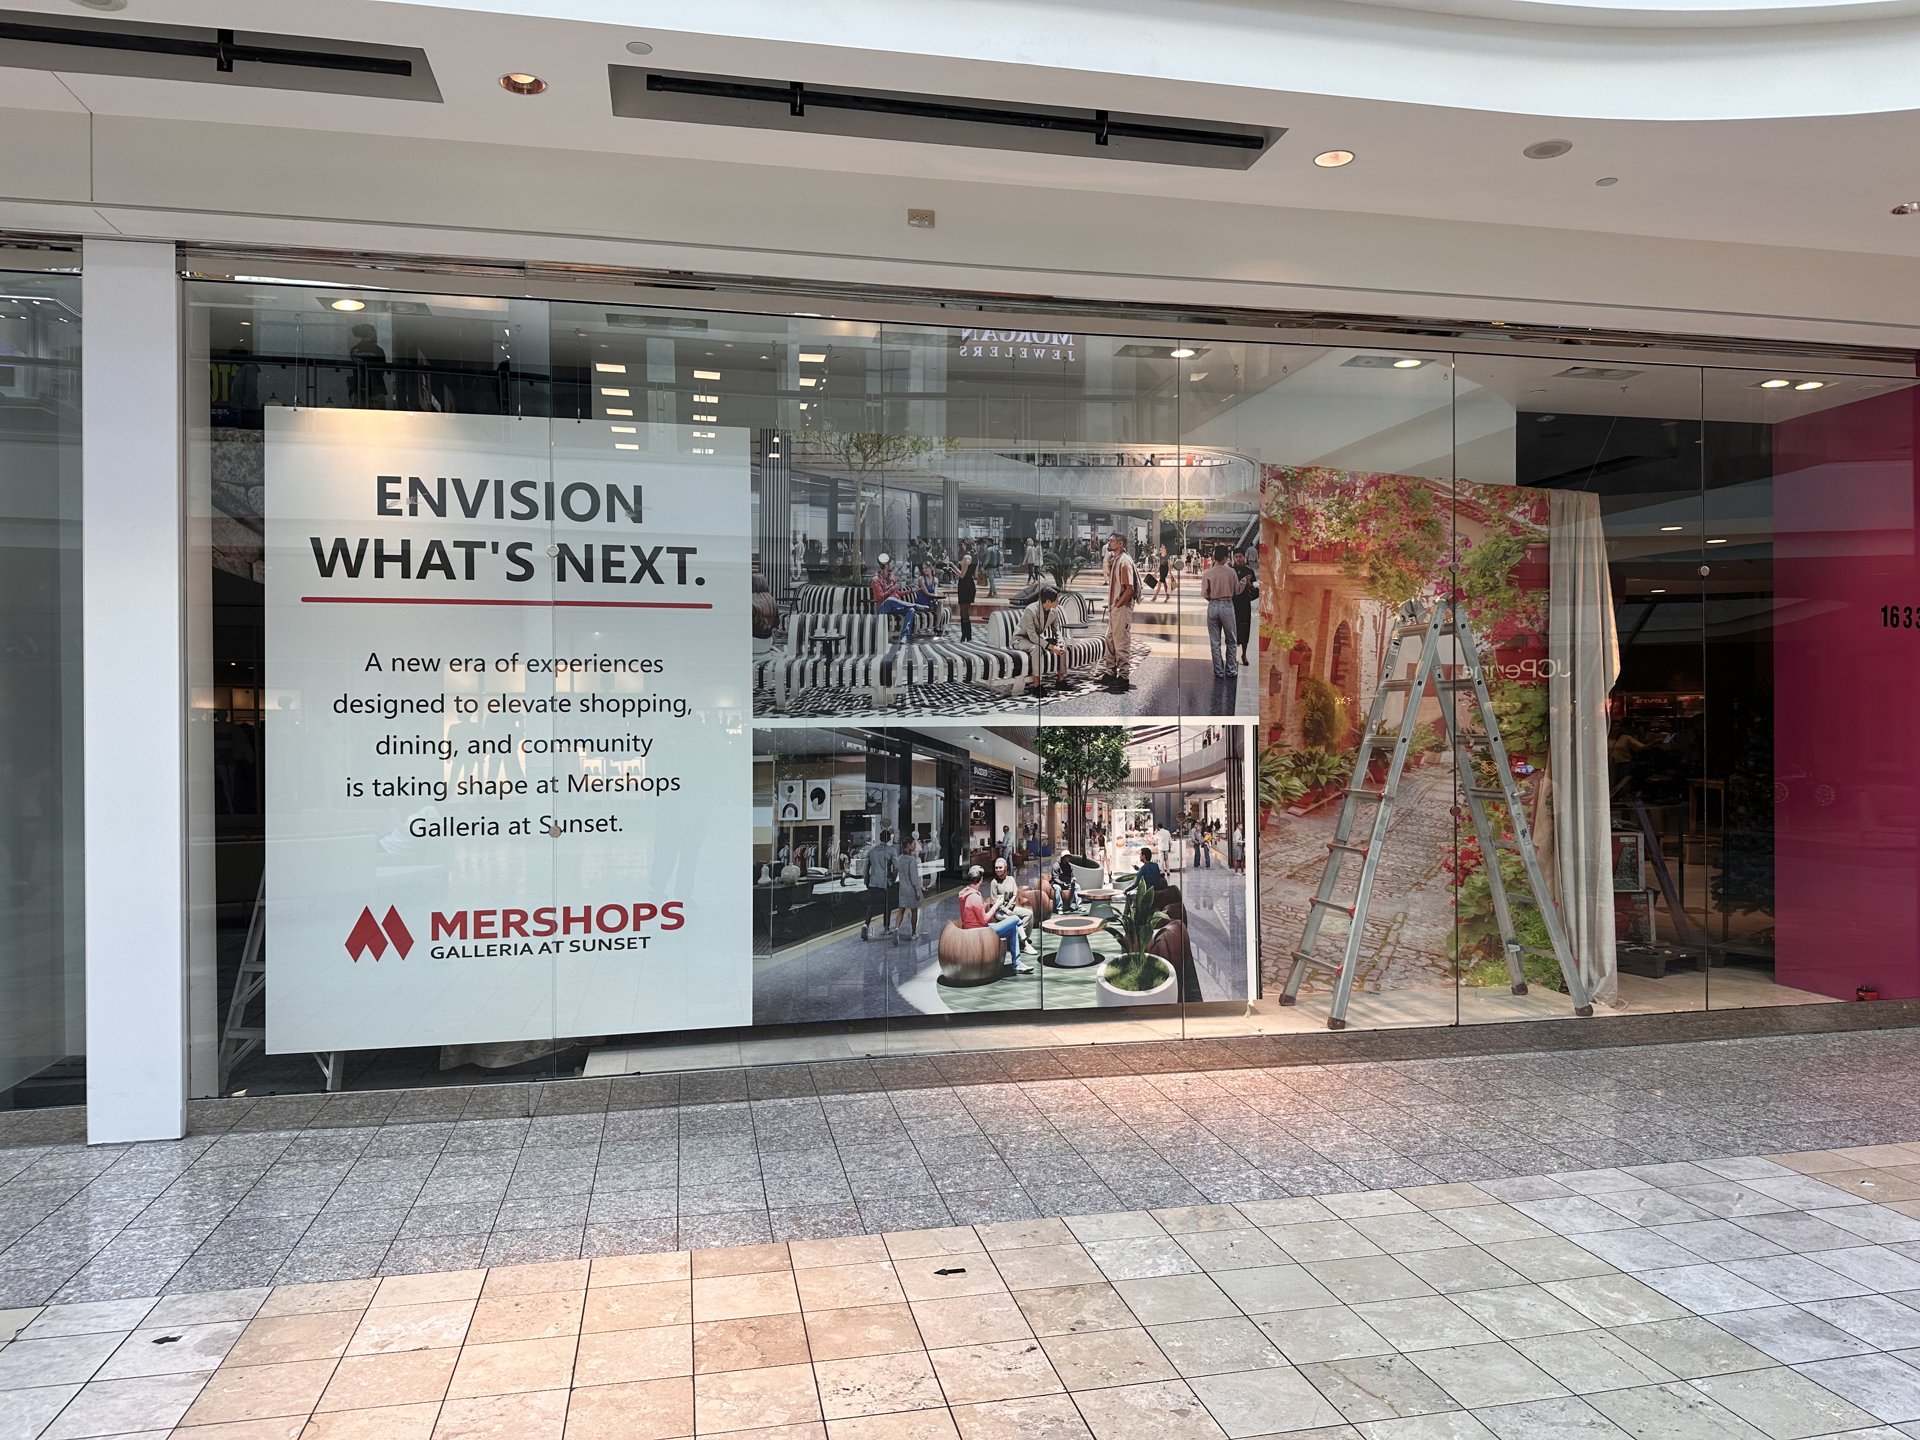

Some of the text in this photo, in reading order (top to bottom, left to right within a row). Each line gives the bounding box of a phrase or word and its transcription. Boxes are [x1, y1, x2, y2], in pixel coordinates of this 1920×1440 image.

[377, 476, 643, 524] ENVISION
[310, 537, 706, 586] WHAT'S NEXT.
[365, 652, 664, 678] A new era of experiences
[333, 693, 692, 720] designed to elevate shopping,
[376, 733, 653, 761] dining, and community
[346, 773, 681, 802] is taking shape at Mershops
[410, 815, 623, 838] Galleria at Sunset.
[431, 902, 685, 942] MERSHOPS
[431, 937, 651, 960] GALLERIA AT SUNSET
